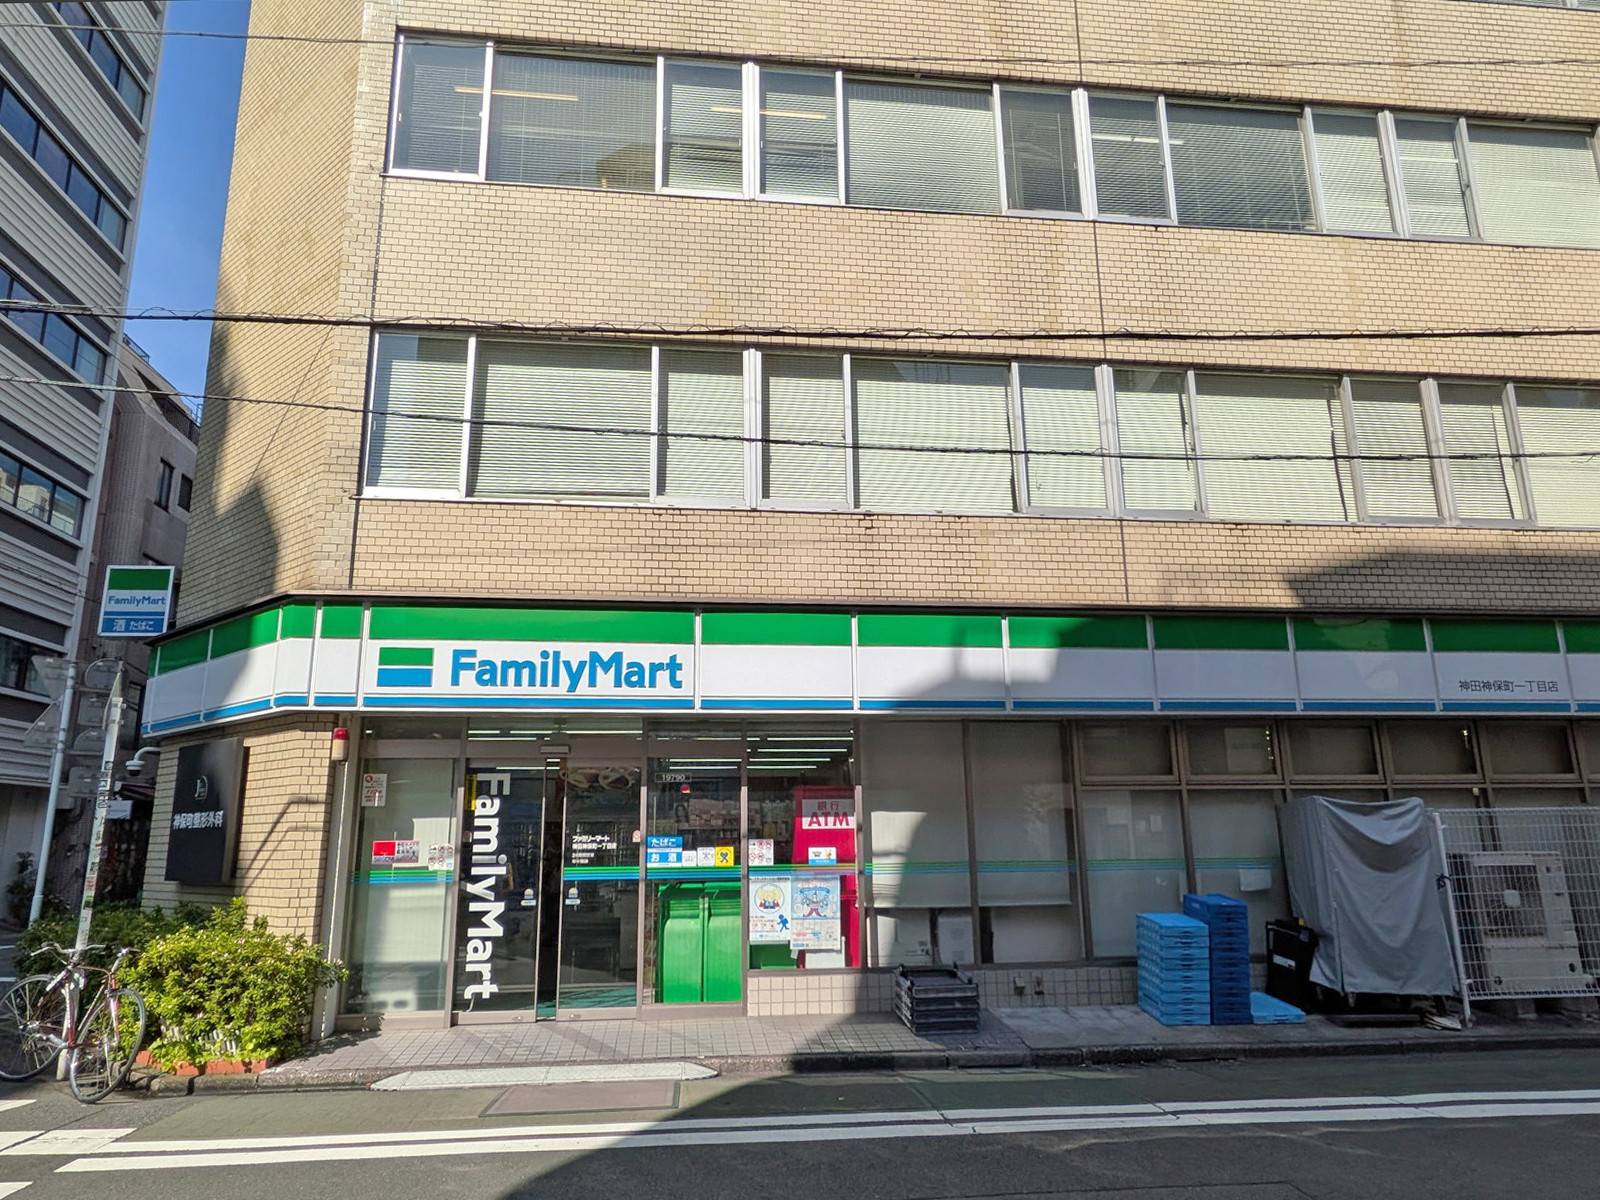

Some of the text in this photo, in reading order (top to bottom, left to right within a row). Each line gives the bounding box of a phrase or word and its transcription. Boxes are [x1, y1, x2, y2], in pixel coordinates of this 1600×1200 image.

[108, 595, 166, 608] FamilyMart
[113, 620, 155, 631] 酒 たばこ
[450, 649, 683, 693] FamilyMart
[1458, 679, 1559, 693] 神田神保町一丁目店
[808, 811, 850, 827] ATM
[651, 838, 677, 847] たばこ
[463, 773, 511, 1000] FamilyMart
